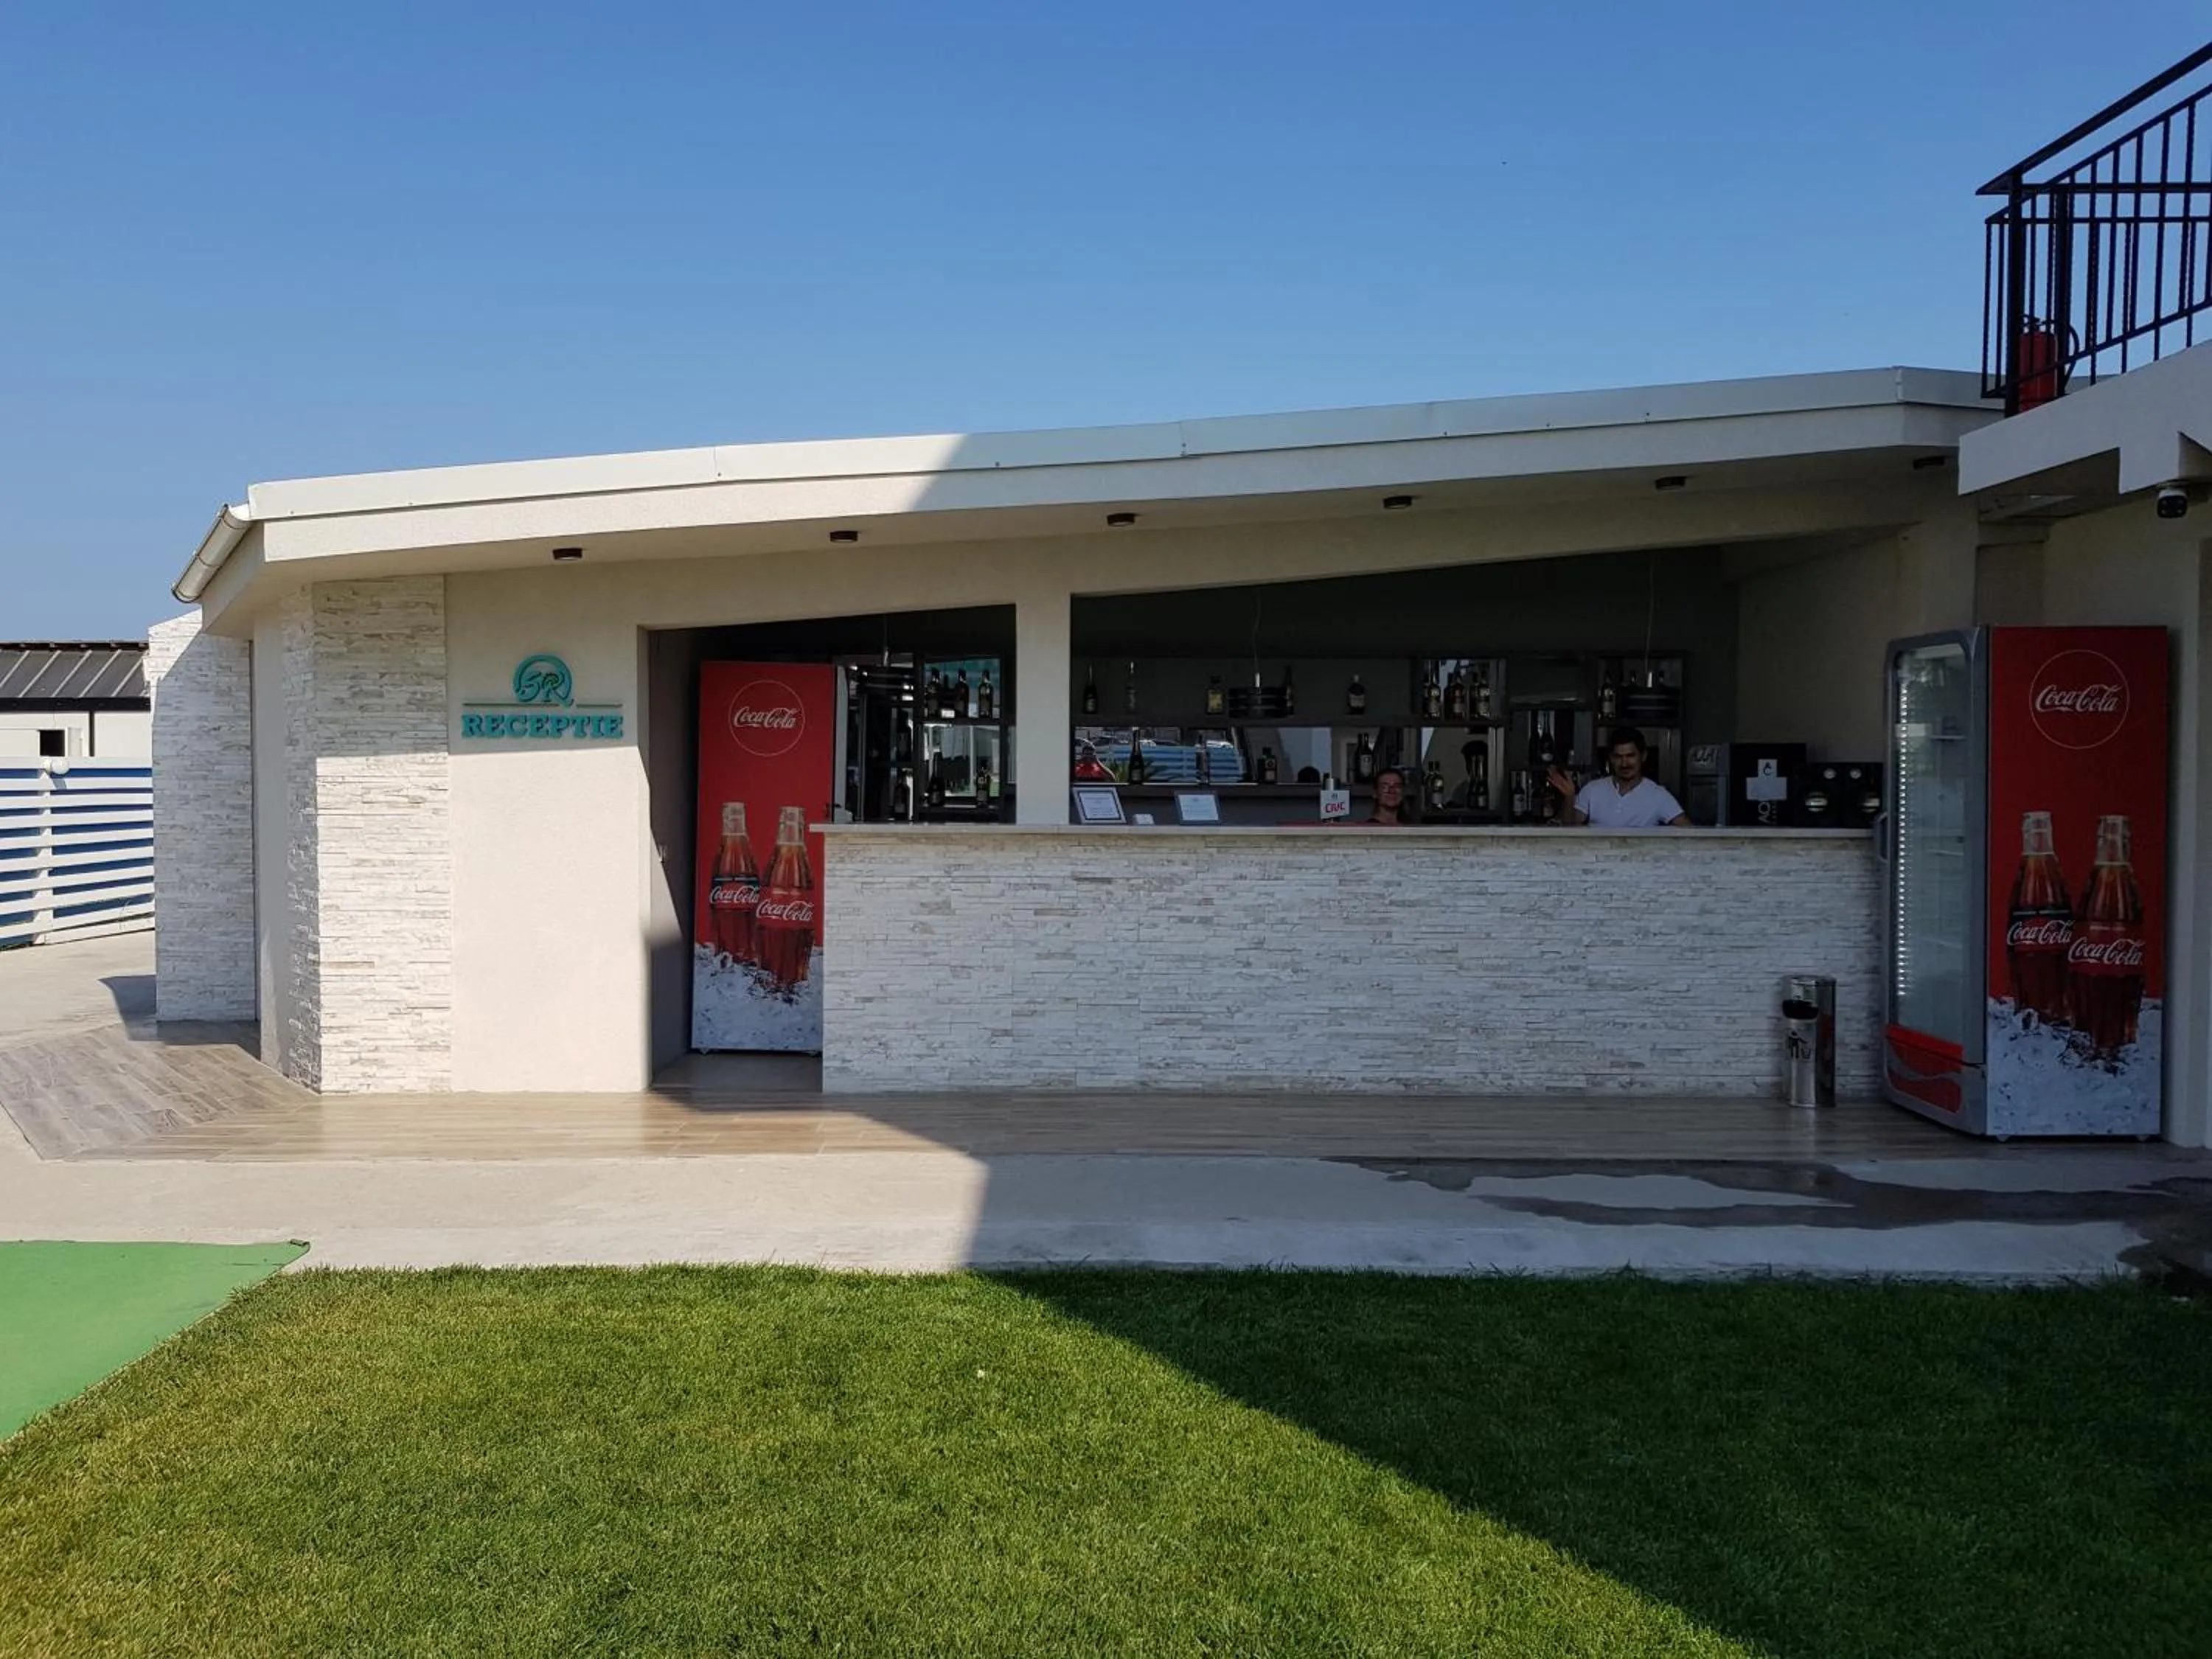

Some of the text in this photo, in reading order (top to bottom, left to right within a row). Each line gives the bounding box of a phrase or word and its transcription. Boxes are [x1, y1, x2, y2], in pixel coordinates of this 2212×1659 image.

[2035, 684, 2124, 712] Coca-Cola
[462, 714, 624, 740] RECEPTIE
[734, 706, 801, 728] Coca-Cola
[709, 885, 761, 904] Coca-Cola
[755, 899, 814, 922] Coca-Cola
[2006, 919, 2076, 947] Coca-Cola
[2067, 936, 2146, 966] Coca-Cola
